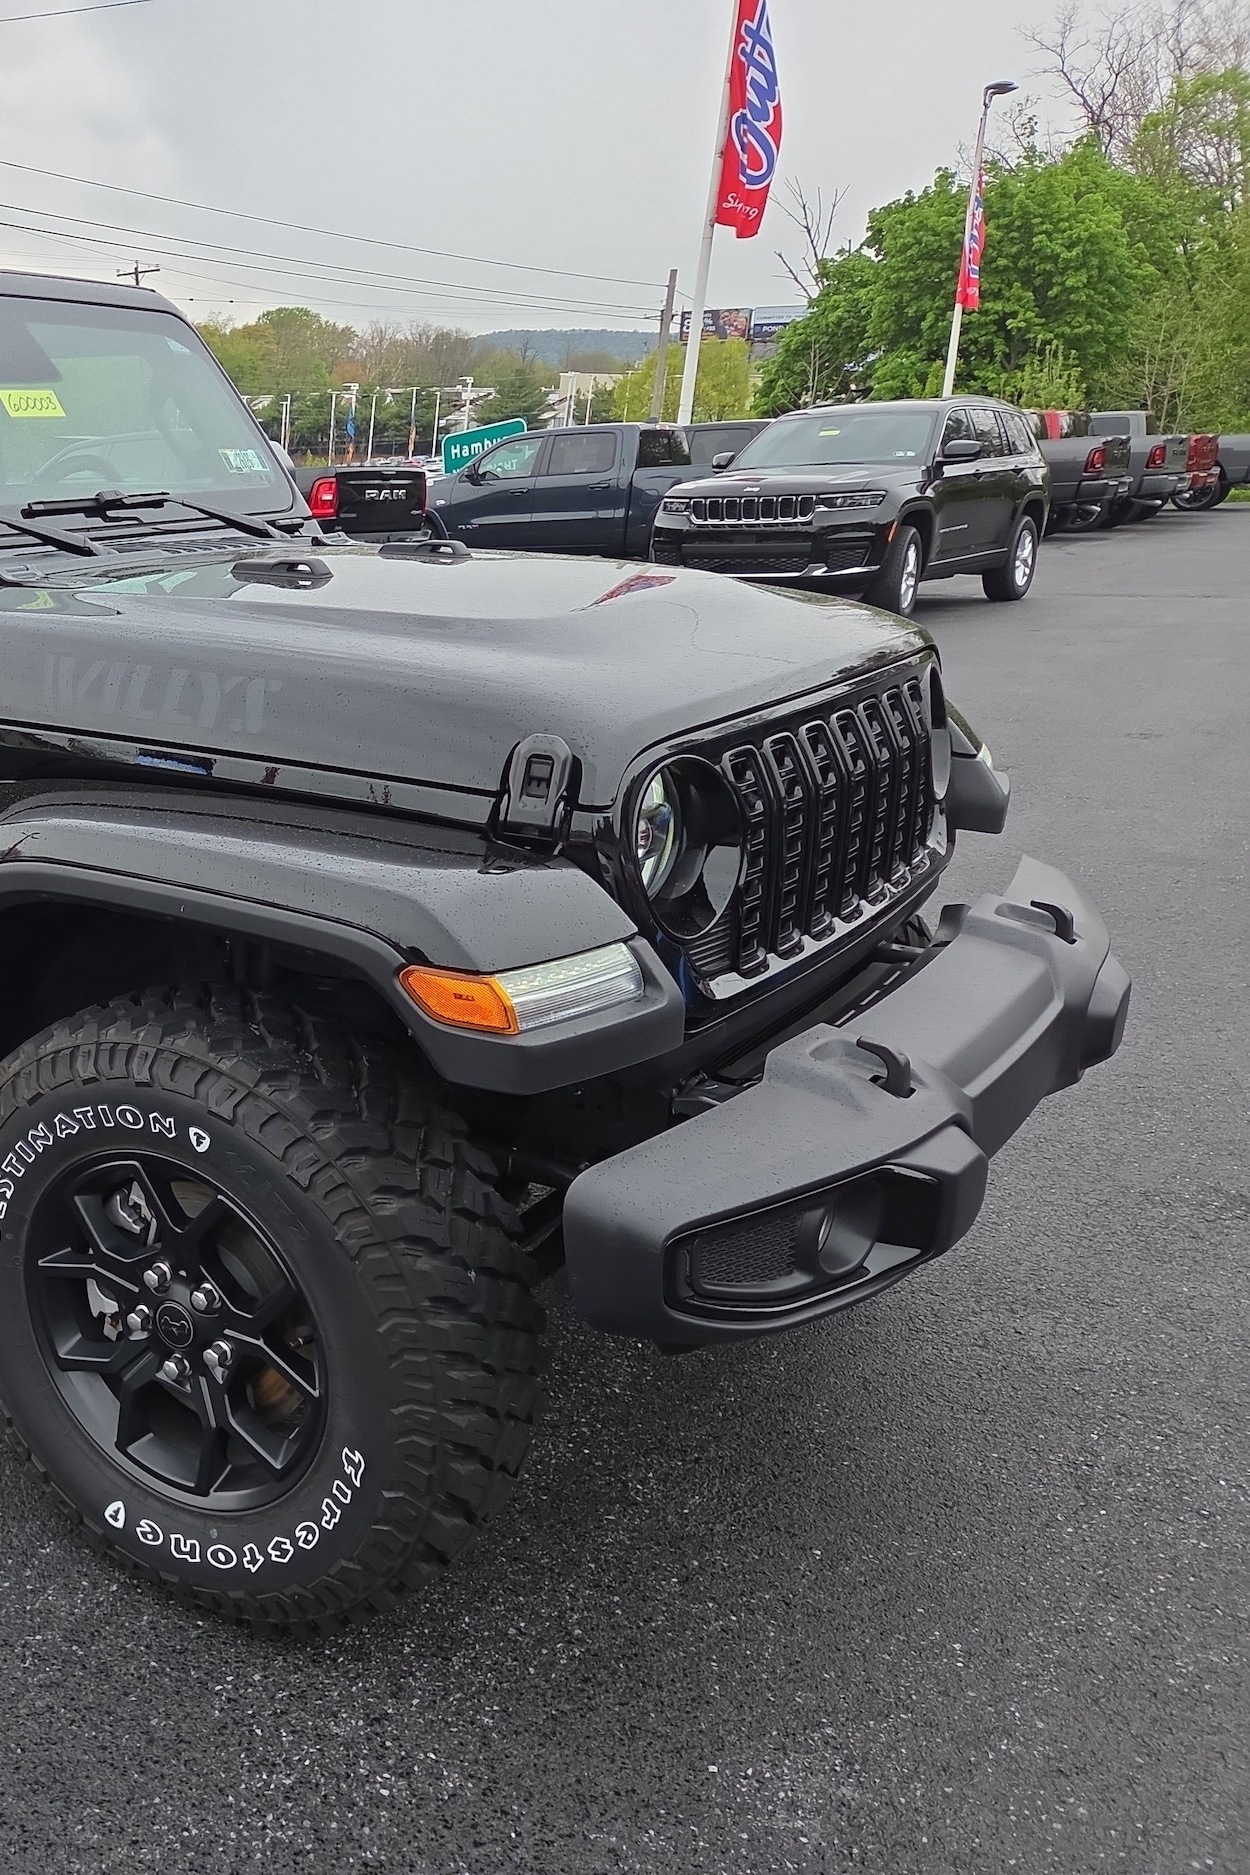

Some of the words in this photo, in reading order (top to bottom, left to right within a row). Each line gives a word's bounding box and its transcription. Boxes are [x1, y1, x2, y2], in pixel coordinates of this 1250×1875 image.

[8, 393, 57, 412] 600003
[451, 436, 509, 459] Hambu
[365, 489, 407, 500] RAM
[46, 654, 283, 734] WILLYS
[136, 1447, 365, 1573] Firestone
